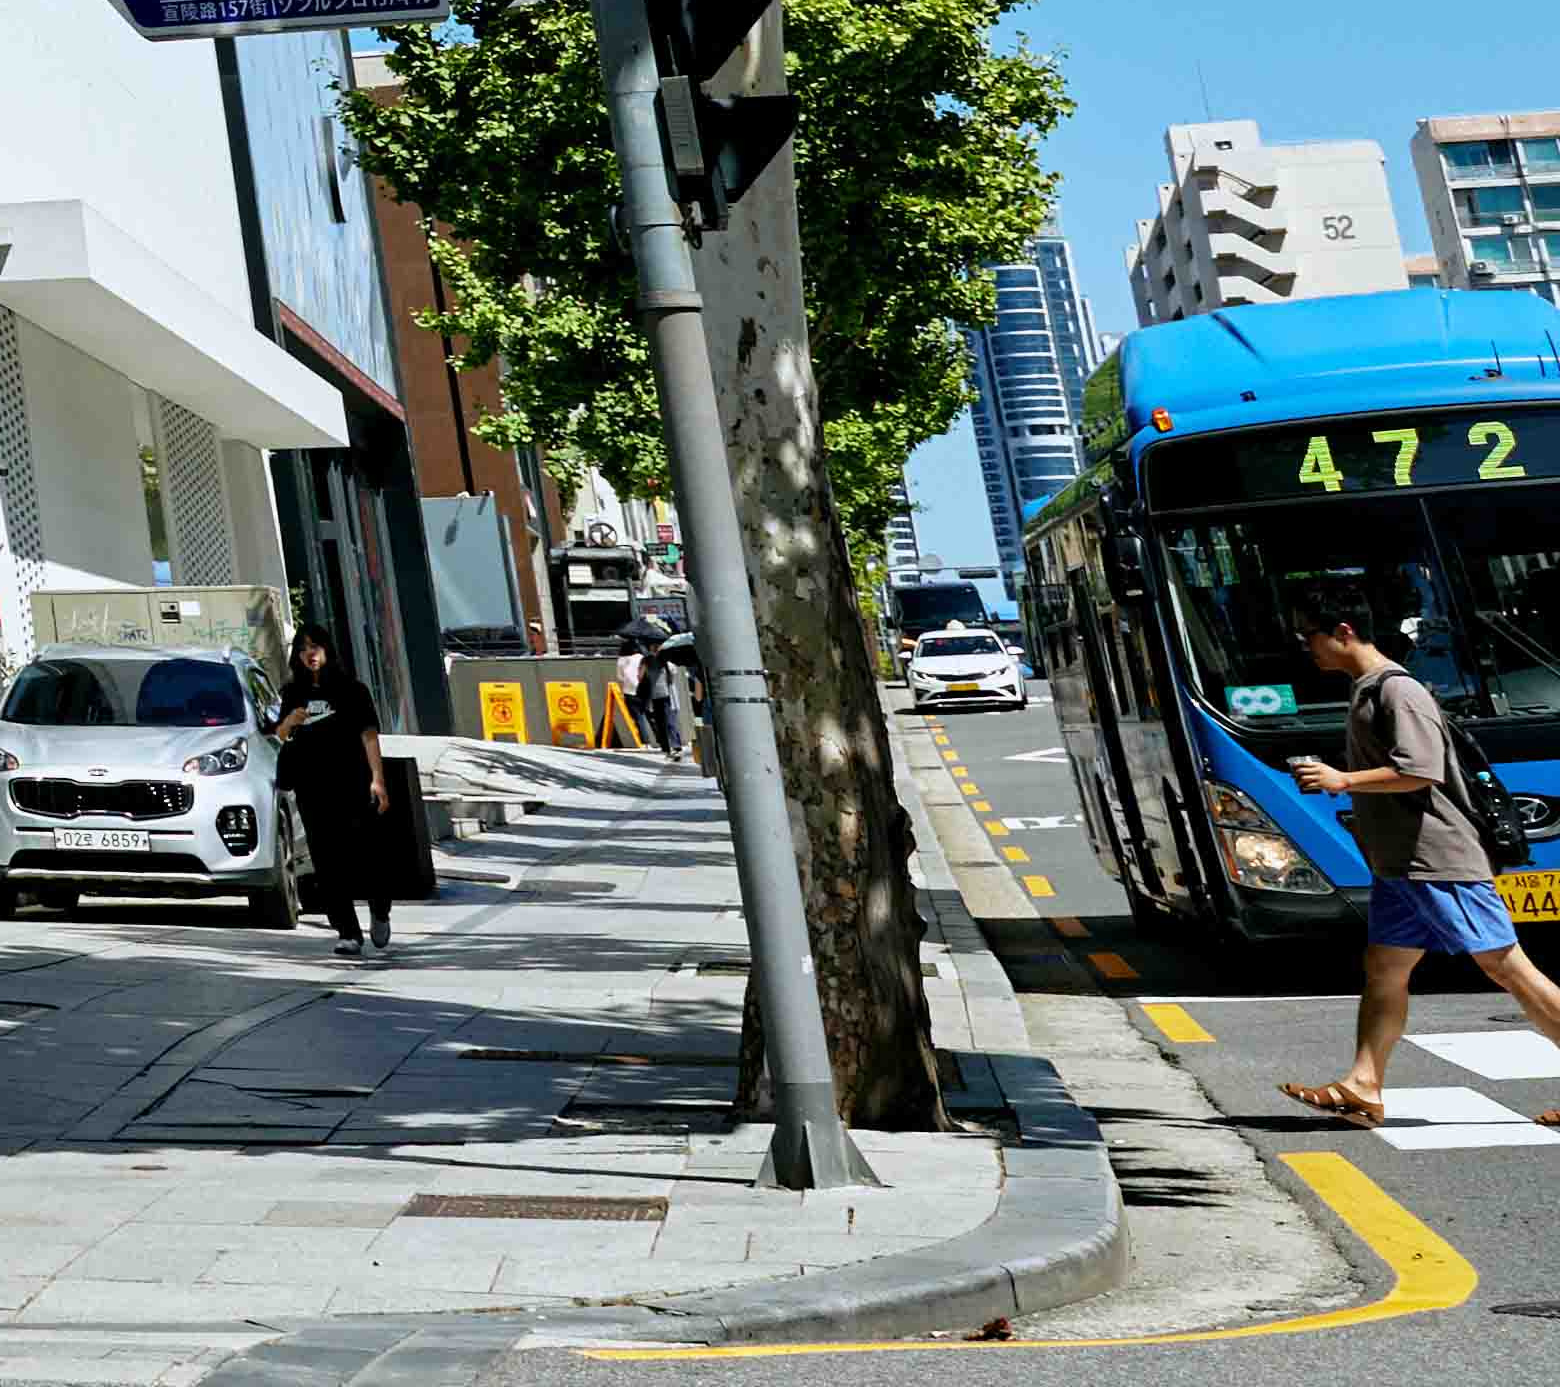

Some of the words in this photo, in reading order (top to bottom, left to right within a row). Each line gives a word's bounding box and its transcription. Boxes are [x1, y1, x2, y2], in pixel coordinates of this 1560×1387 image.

[1322, 214, 1356, 240] 52
[100, 832, 141, 849] 6859
[1544, 873, 1560, 888] 7
